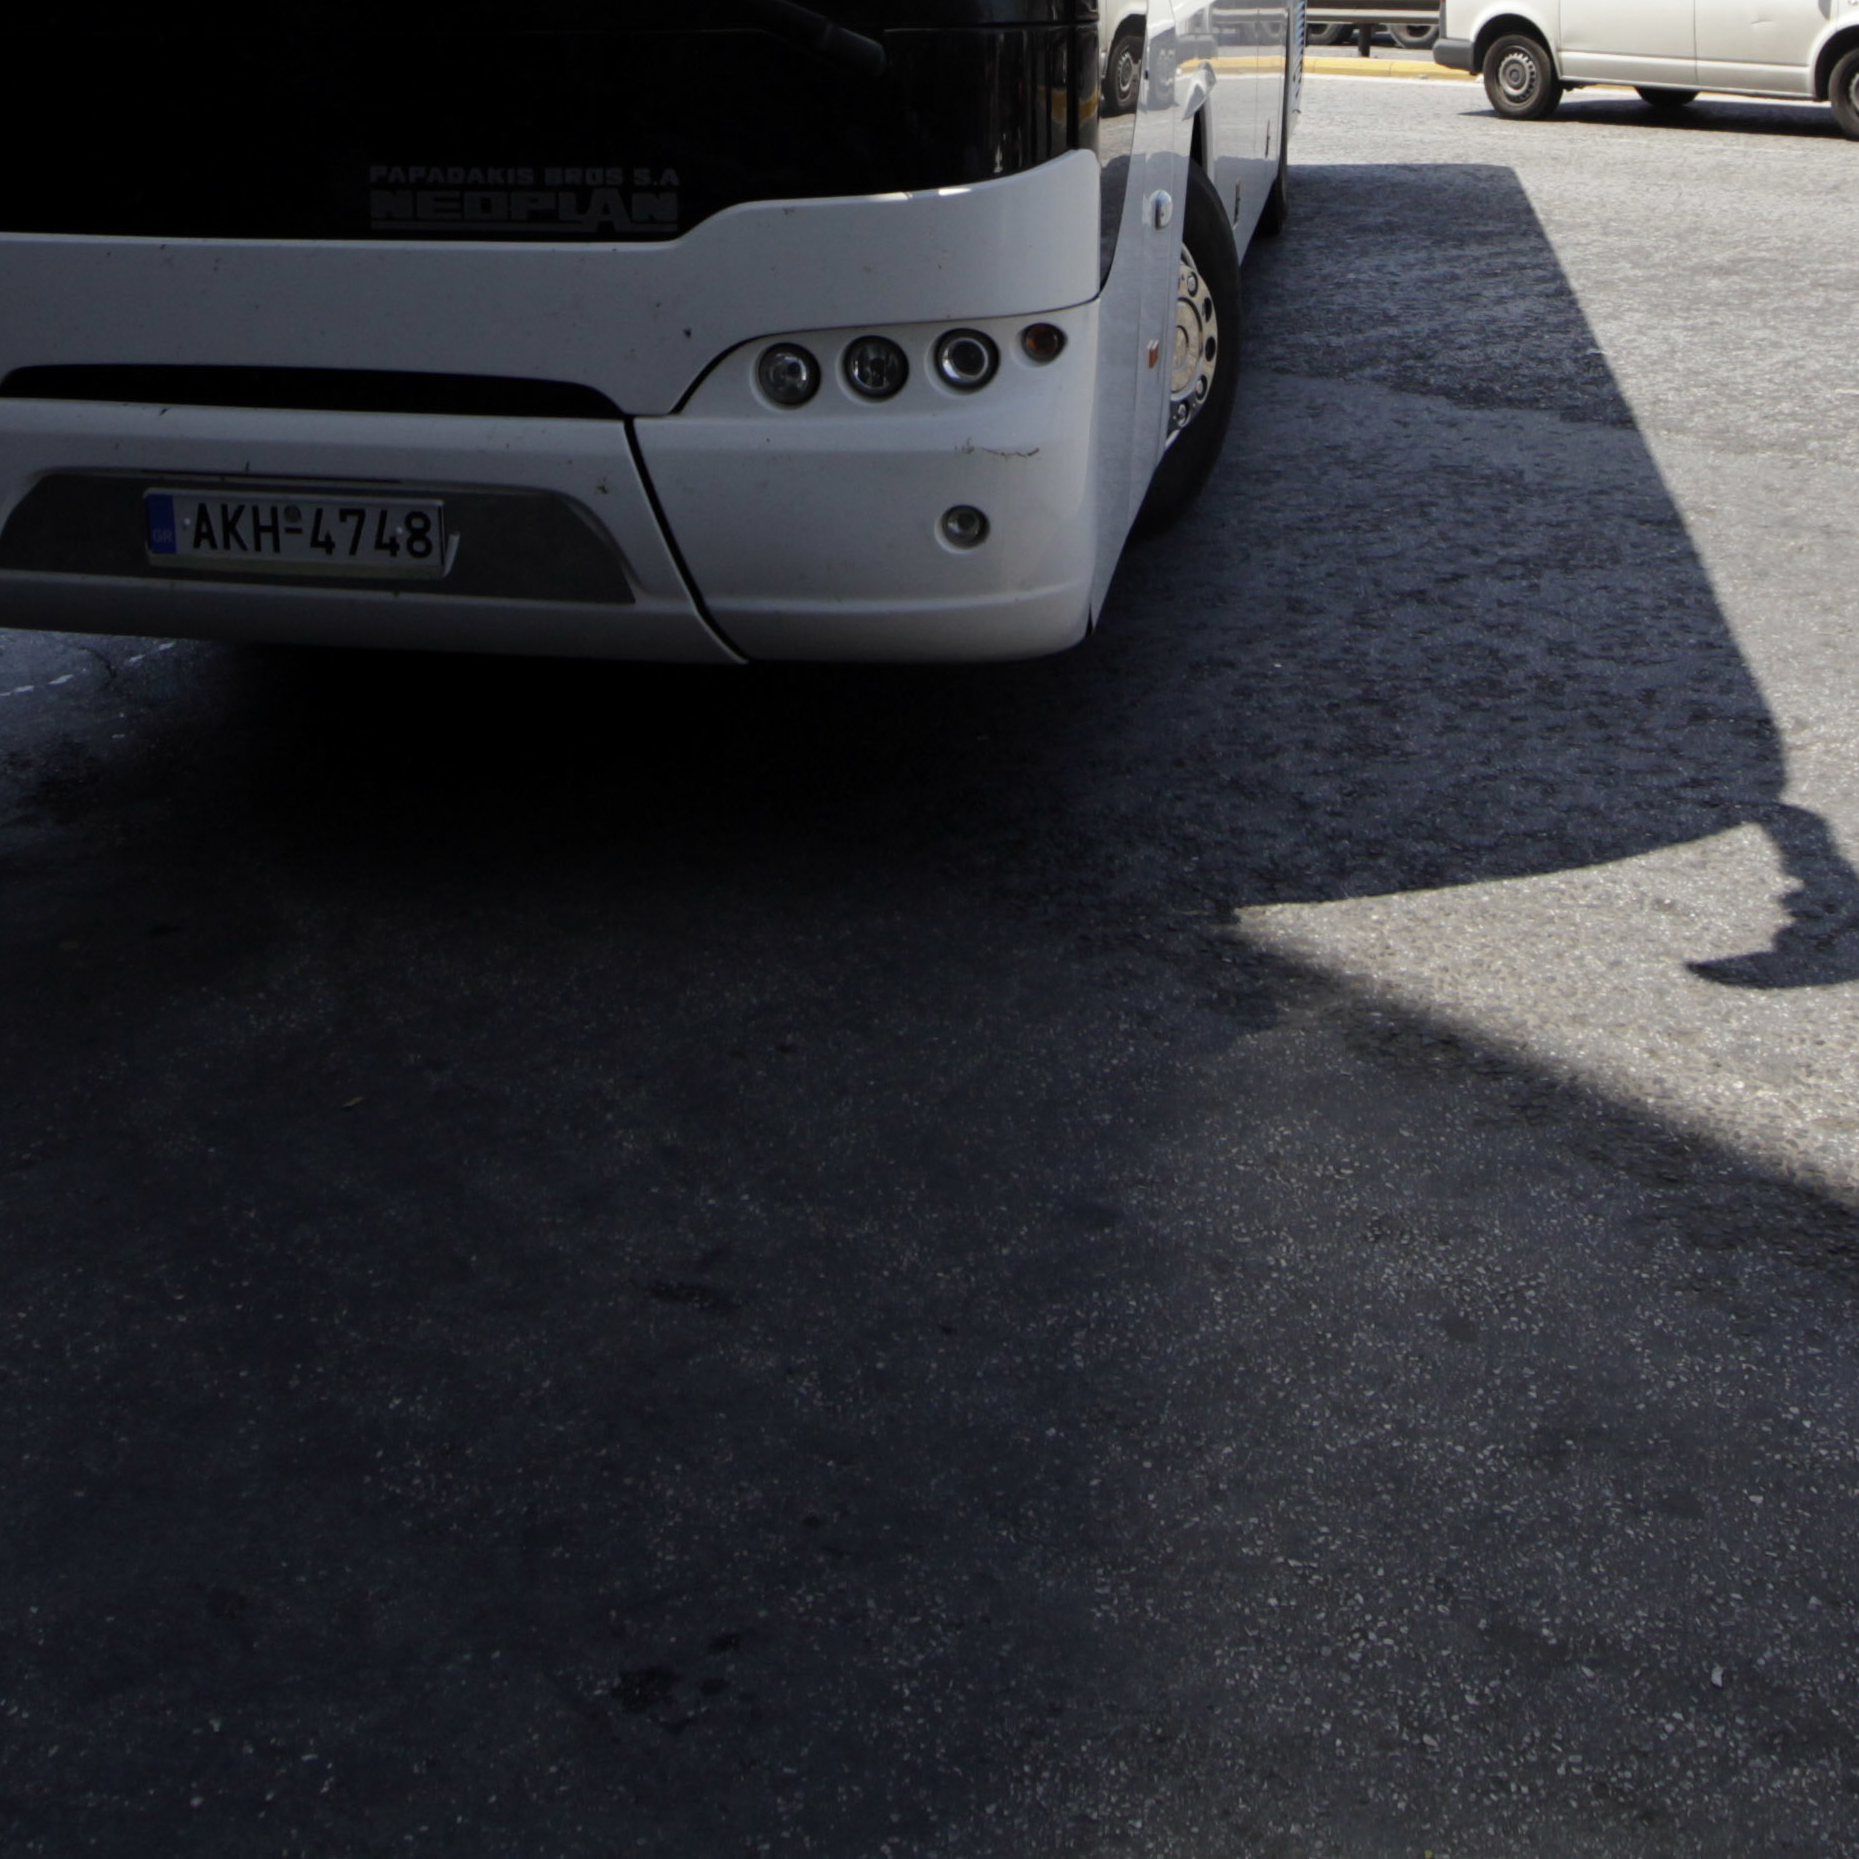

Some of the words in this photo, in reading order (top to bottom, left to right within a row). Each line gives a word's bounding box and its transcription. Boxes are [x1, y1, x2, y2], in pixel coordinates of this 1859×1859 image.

[368, 164, 537, 186] PAPADAKIS
[543, 166, 625, 187] BROS
[370, 187, 679, 233] NEOPLAN
